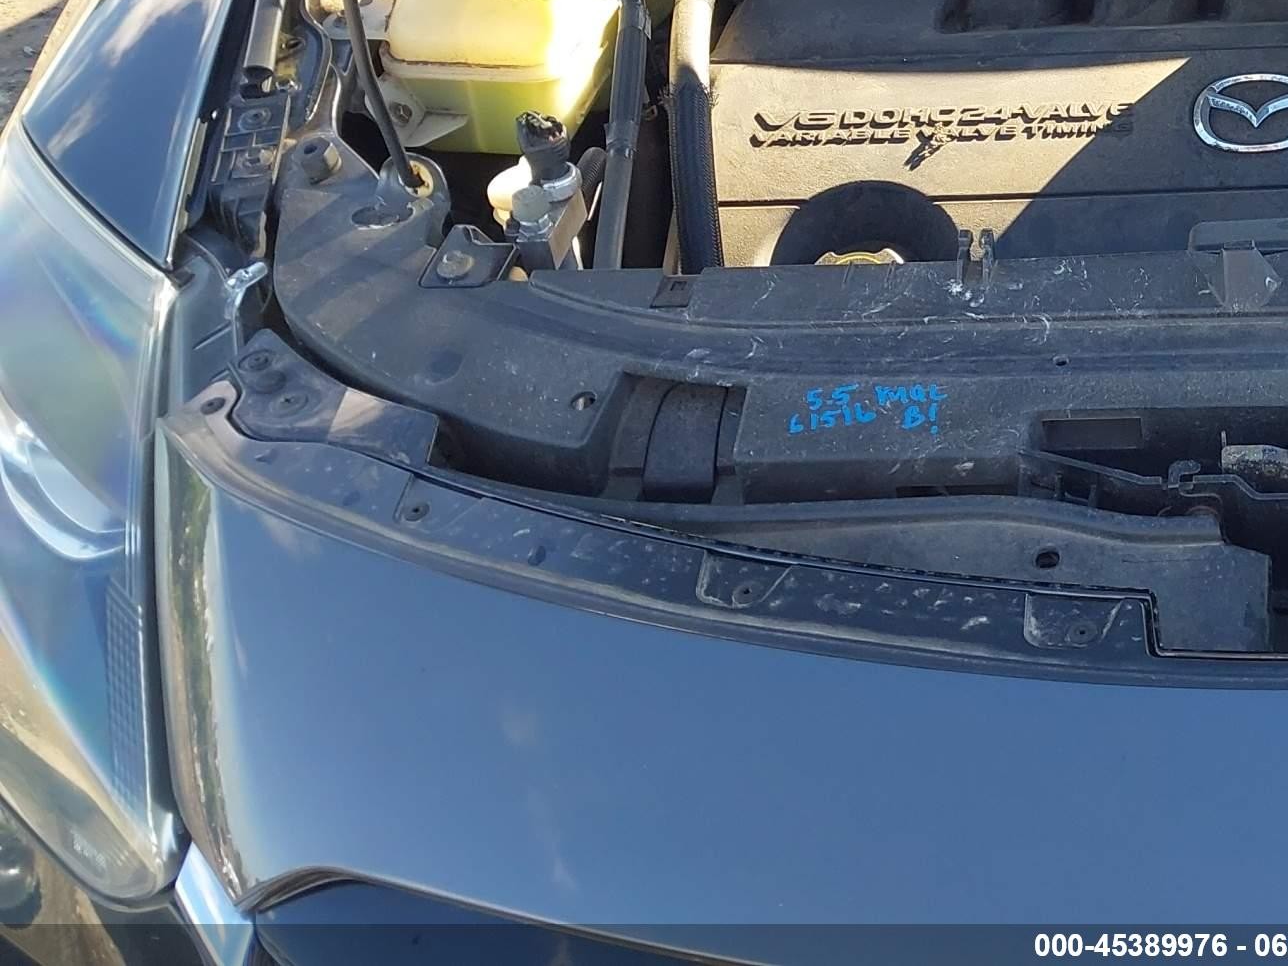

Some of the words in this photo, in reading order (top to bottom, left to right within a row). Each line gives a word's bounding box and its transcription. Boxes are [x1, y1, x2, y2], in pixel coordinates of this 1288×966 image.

[751, 109, 838, 132] V6
[838, 106, 957, 130] DOHC
[748, 127, 911, 148] VARIABLE
